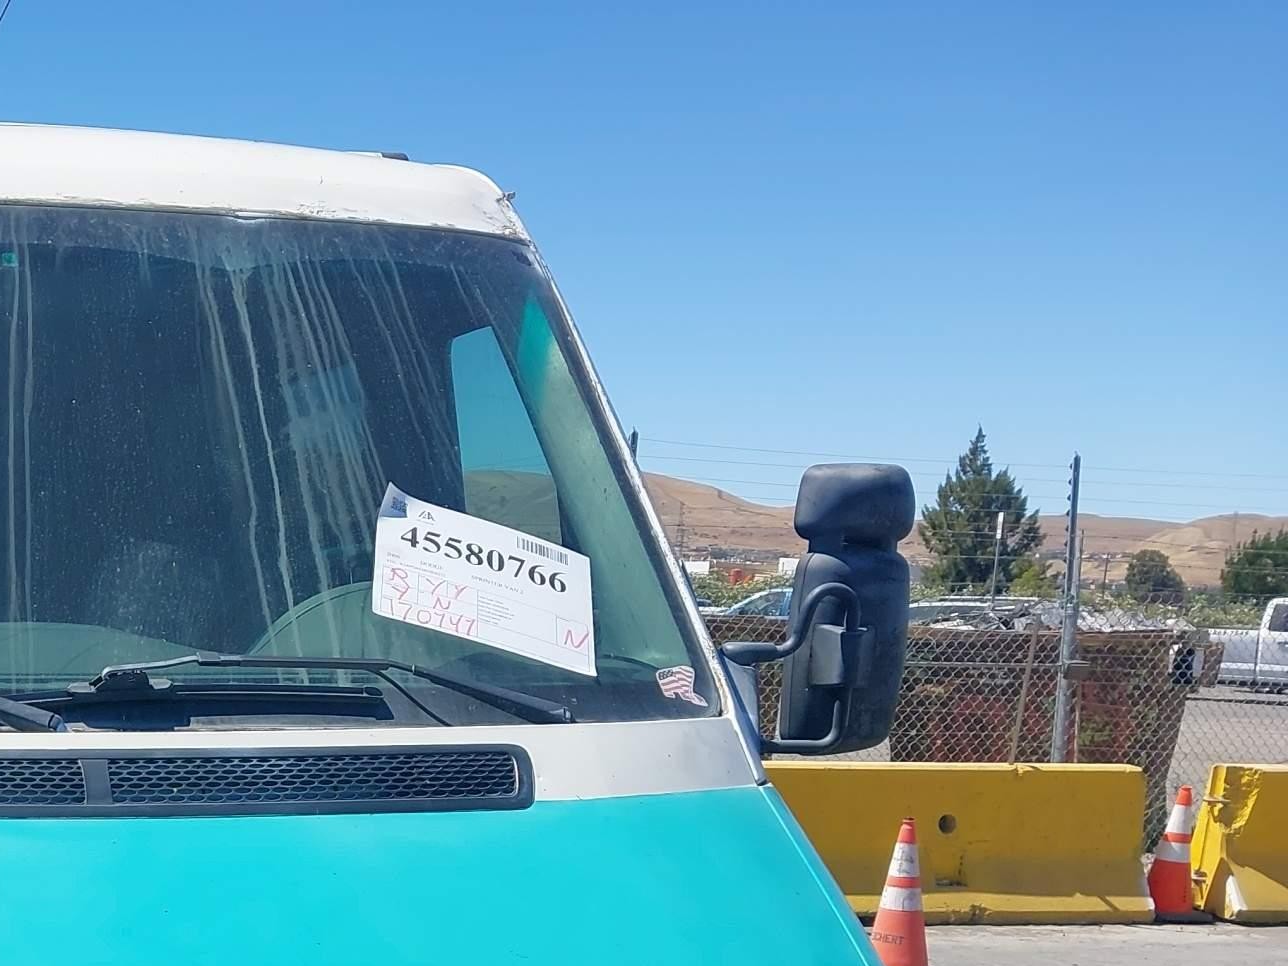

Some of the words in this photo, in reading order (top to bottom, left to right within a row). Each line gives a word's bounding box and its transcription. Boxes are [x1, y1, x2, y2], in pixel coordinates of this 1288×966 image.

[399, 525, 567, 593] 45580766
[432, 597, 452, 610] N
[564, 629, 590, 649] N
